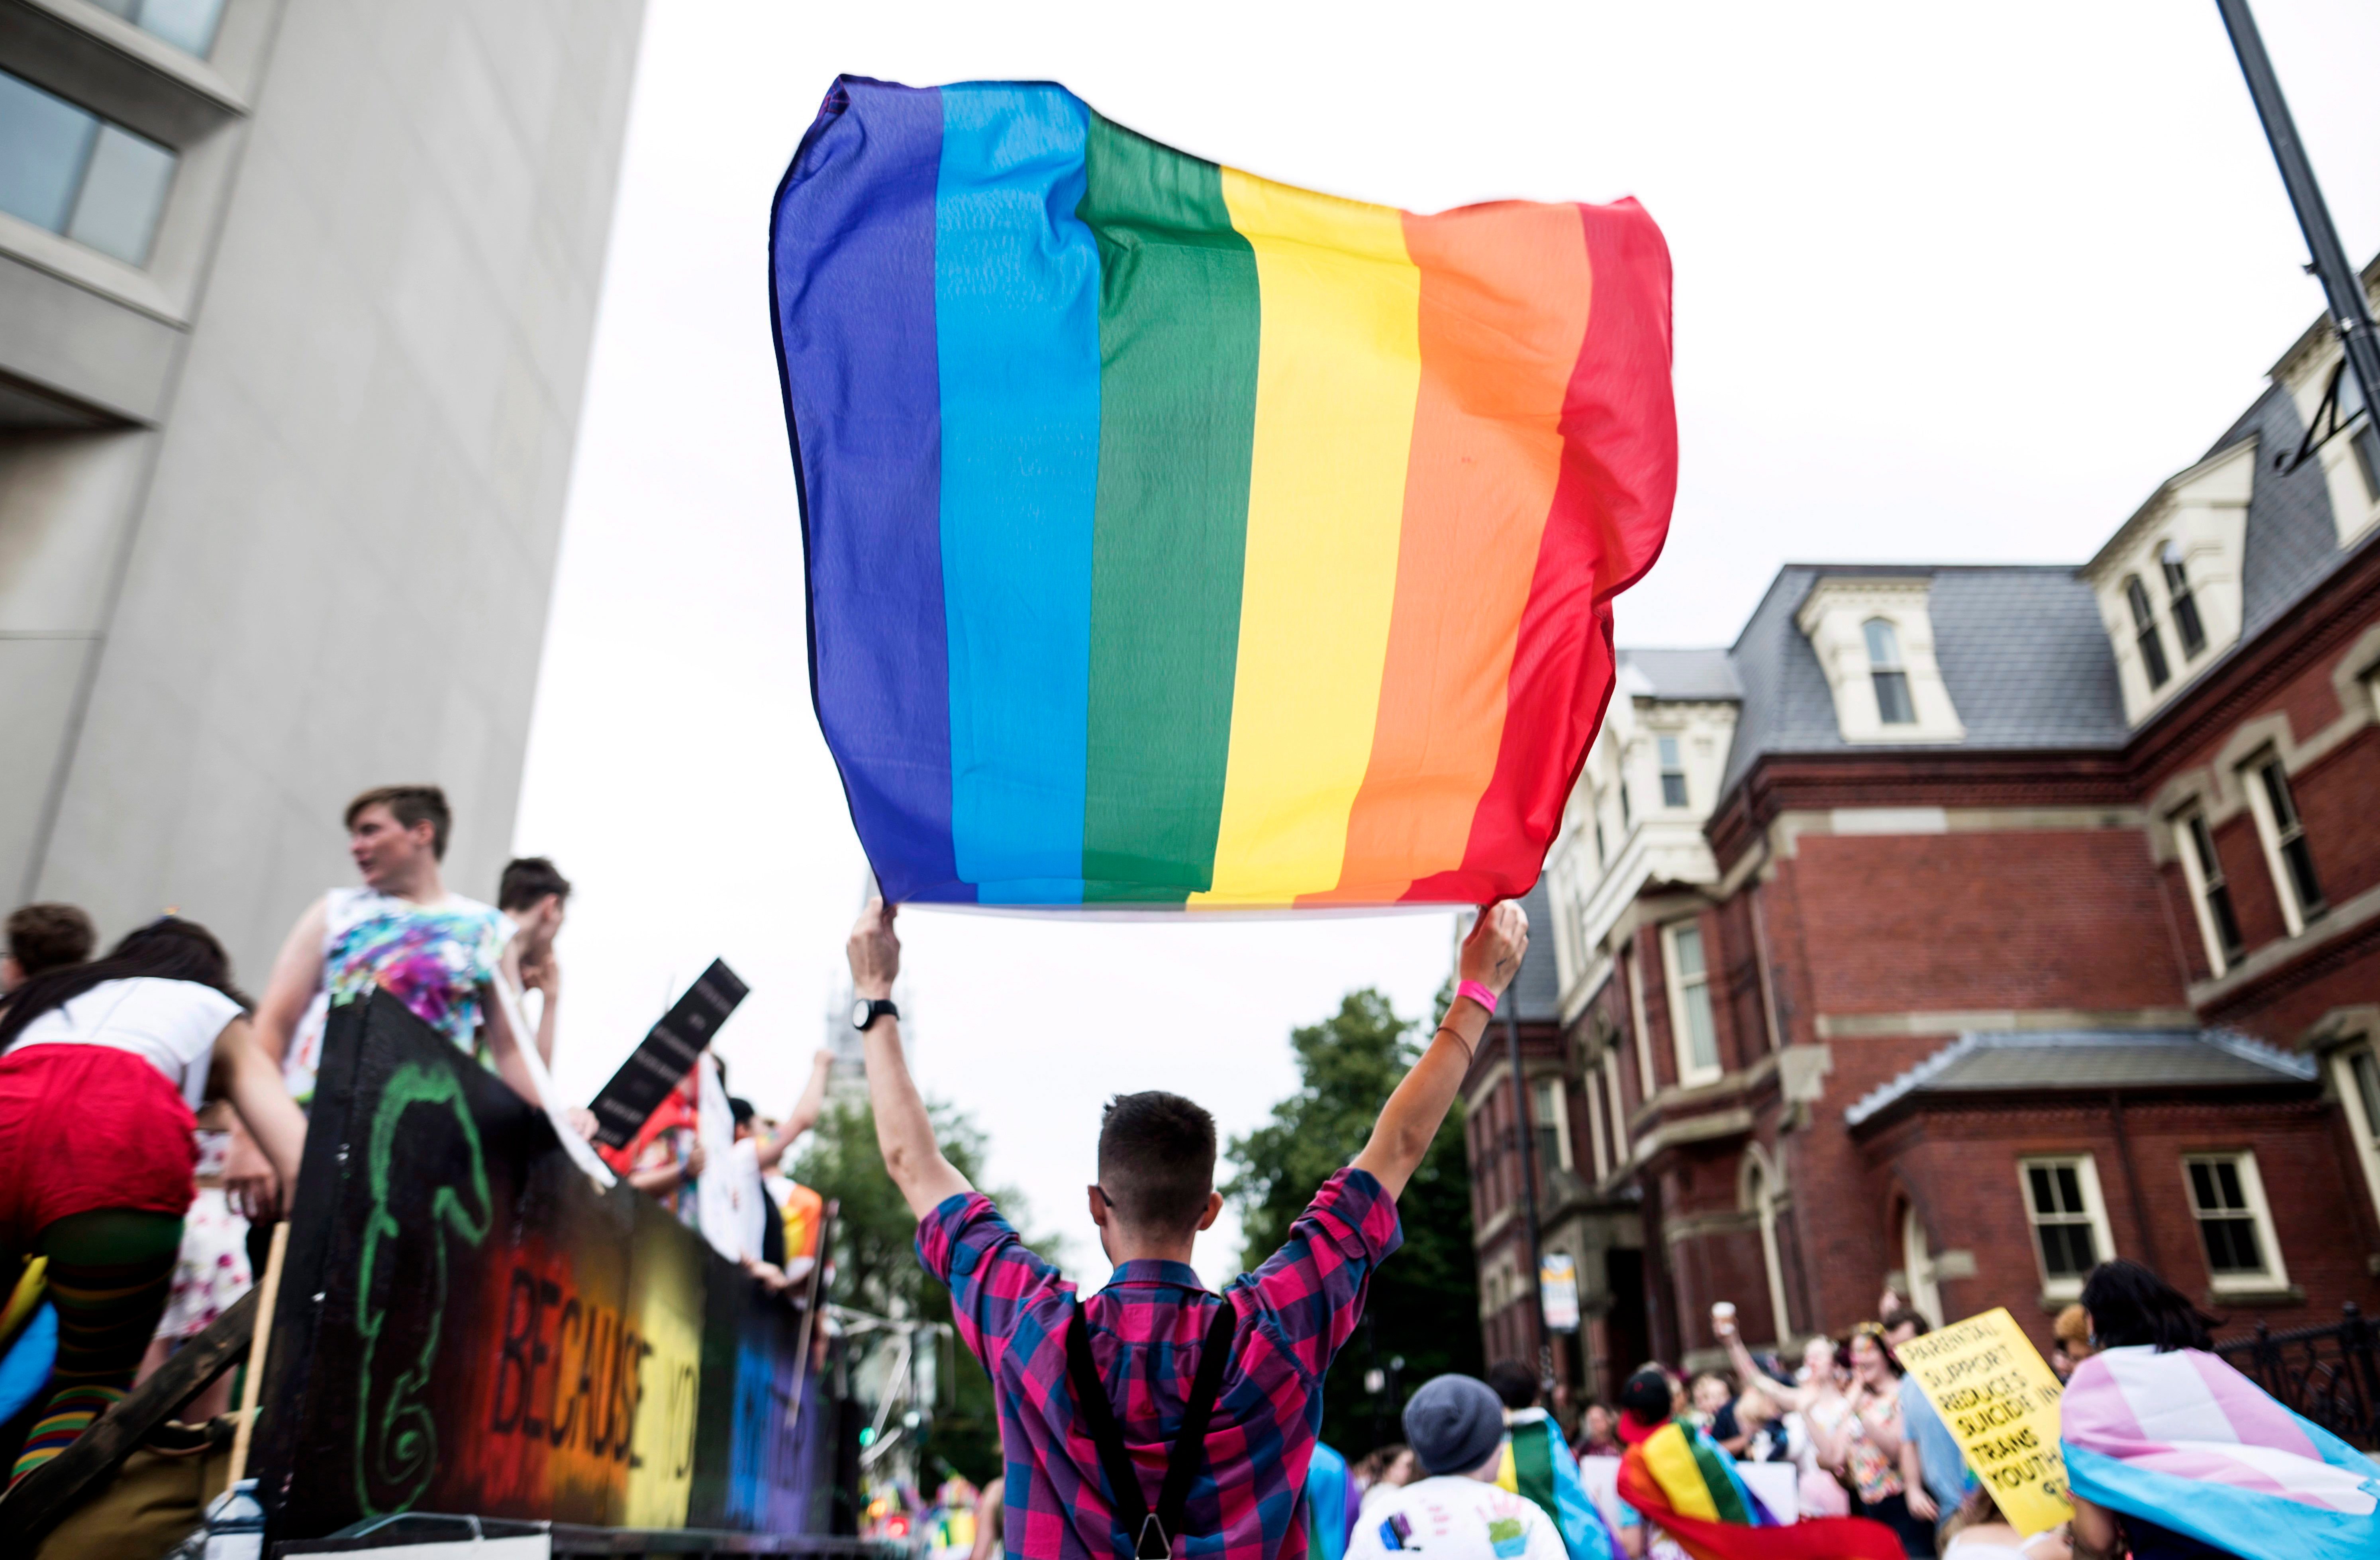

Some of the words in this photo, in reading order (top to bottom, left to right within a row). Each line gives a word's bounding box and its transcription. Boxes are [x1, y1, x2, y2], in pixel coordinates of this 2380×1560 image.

[1905, 1321, 2001, 1361] PARENTAL
[492, 1267, 653, 1469] BECAUSE
[1924, 1344, 2014, 1389] SUPPORT
[1937, 1370, 2028, 1413] REDUCES
[1957, 1395, 2036, 1437] SUICIDE
[1972, 1427, 2039, 1466] TRANS
[1986, 1447, 2064, 1492] YOUTH
